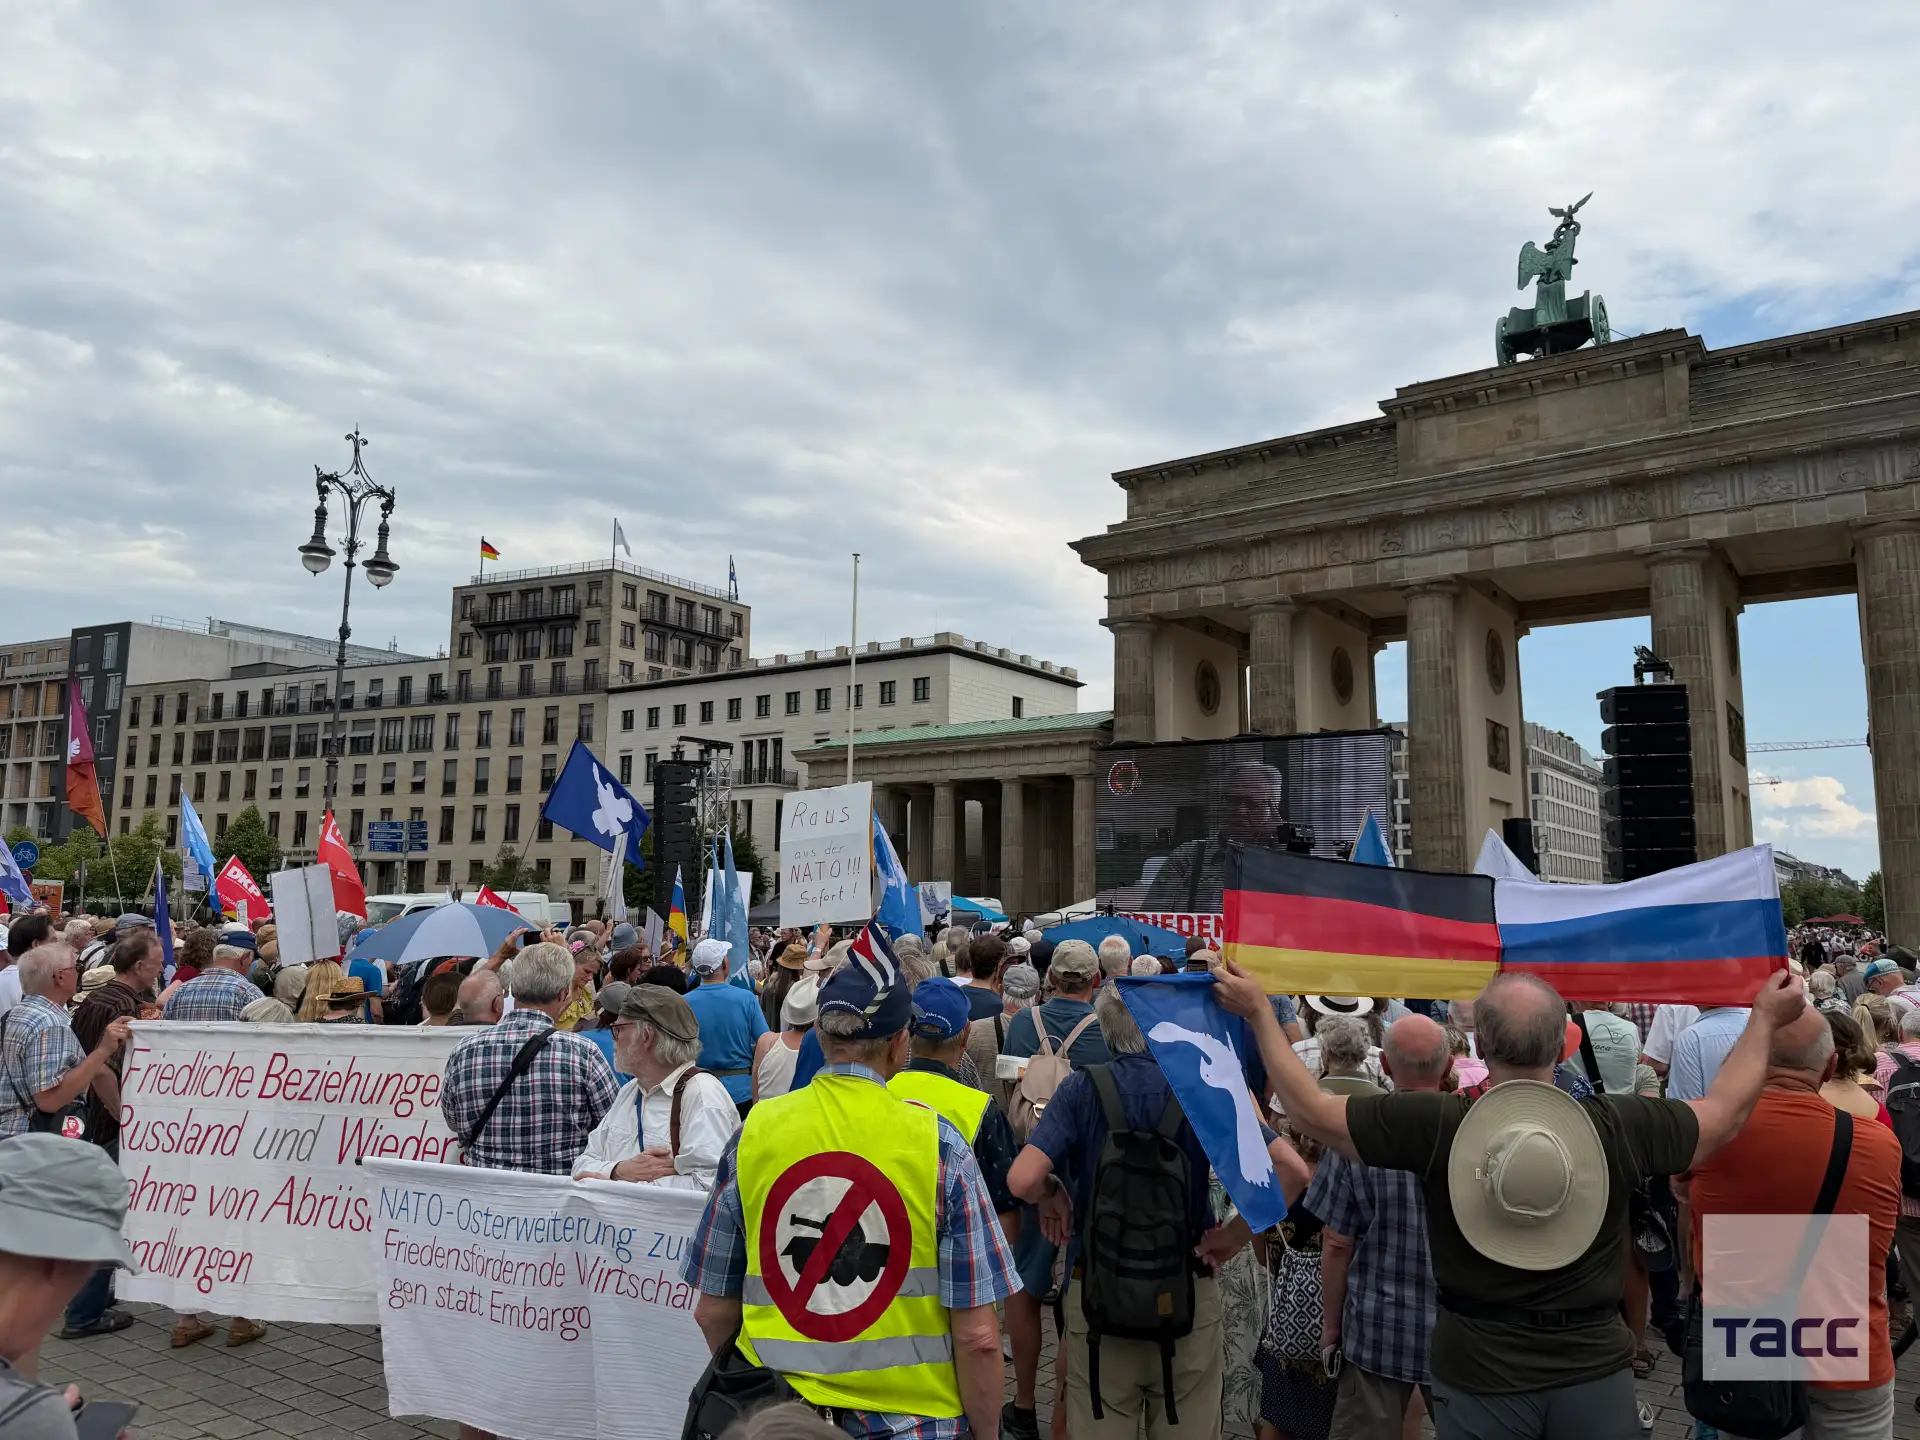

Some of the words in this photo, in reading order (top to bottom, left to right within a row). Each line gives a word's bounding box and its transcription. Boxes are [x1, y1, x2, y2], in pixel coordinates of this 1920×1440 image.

[790, 801, 850, 829] Raus
[794, 849, 817, 860] aus
[824, 840, 845, 855] der
[226, 865, 261, 897] DKP
[798, 885, 843, 908] Sofort
[1592, 1042, 1612, 1052] ioca
[121, 1047, 254, 1099] Friedliche
[119, 1104, 248, 1157] Russland
[253, 1114, 325, 1162] und
[337, 1115, 474, 1166] Wieder
[208, 1185, 260, 1222] von
[123, 1227, 253, 1294] ndlungen
[384, 1228, 566, 1288] Friedensfördernde
[388, 1277, 428, 1309] gen
[435, 1281, 484, 1317] statt
[489, 1290, 592, 1341] Embargo
